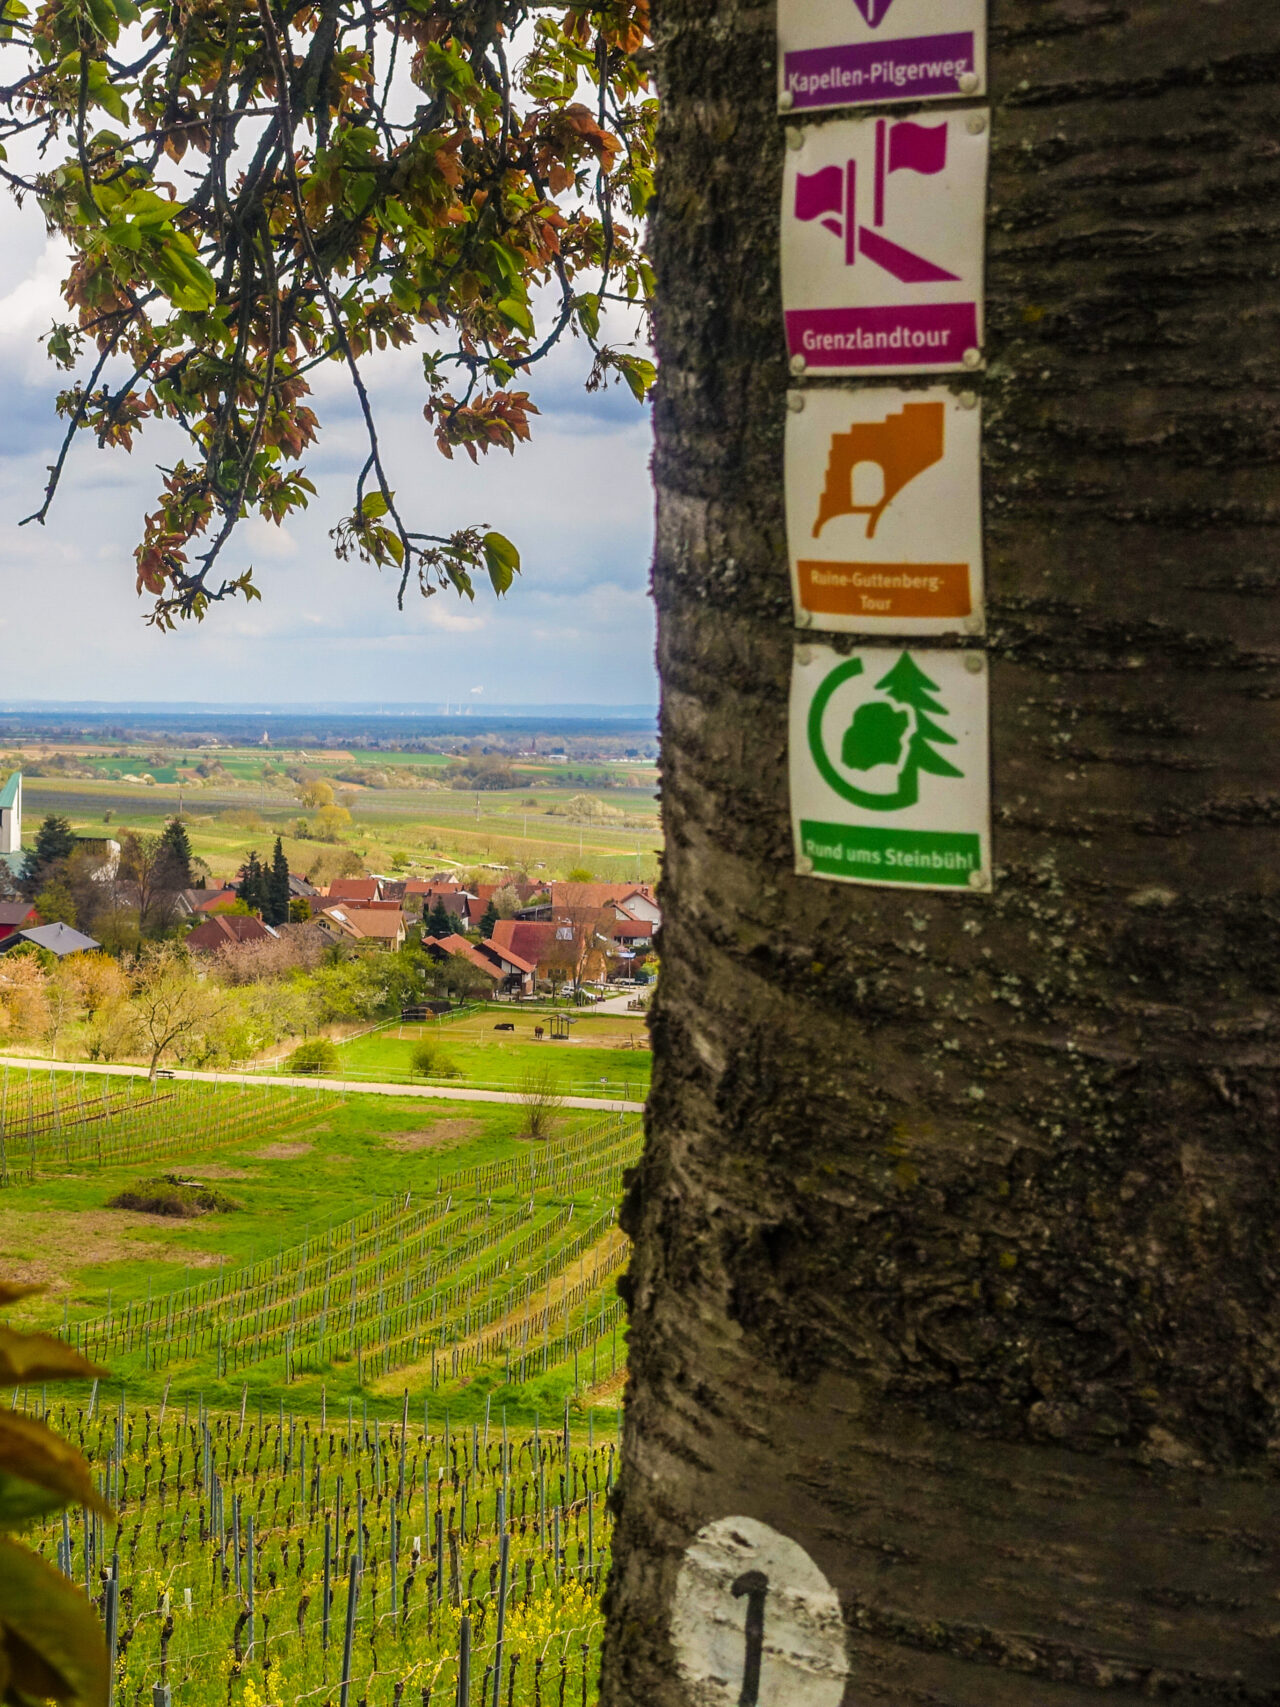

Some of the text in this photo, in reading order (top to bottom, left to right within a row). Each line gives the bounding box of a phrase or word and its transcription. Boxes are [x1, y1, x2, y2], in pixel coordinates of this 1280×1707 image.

[788, 58, 968, 95] Kapellen-Pilgerweg
[803, 326, 951, 350] Grenzlandtour
[811, 570, 945, 592] Ruine-Guttenberg-
[859, 595, 892, 610] Tour
[806, 839, 974, 870] Rund ums Steinbühl
[731, 1570, 768, 1707] 1
